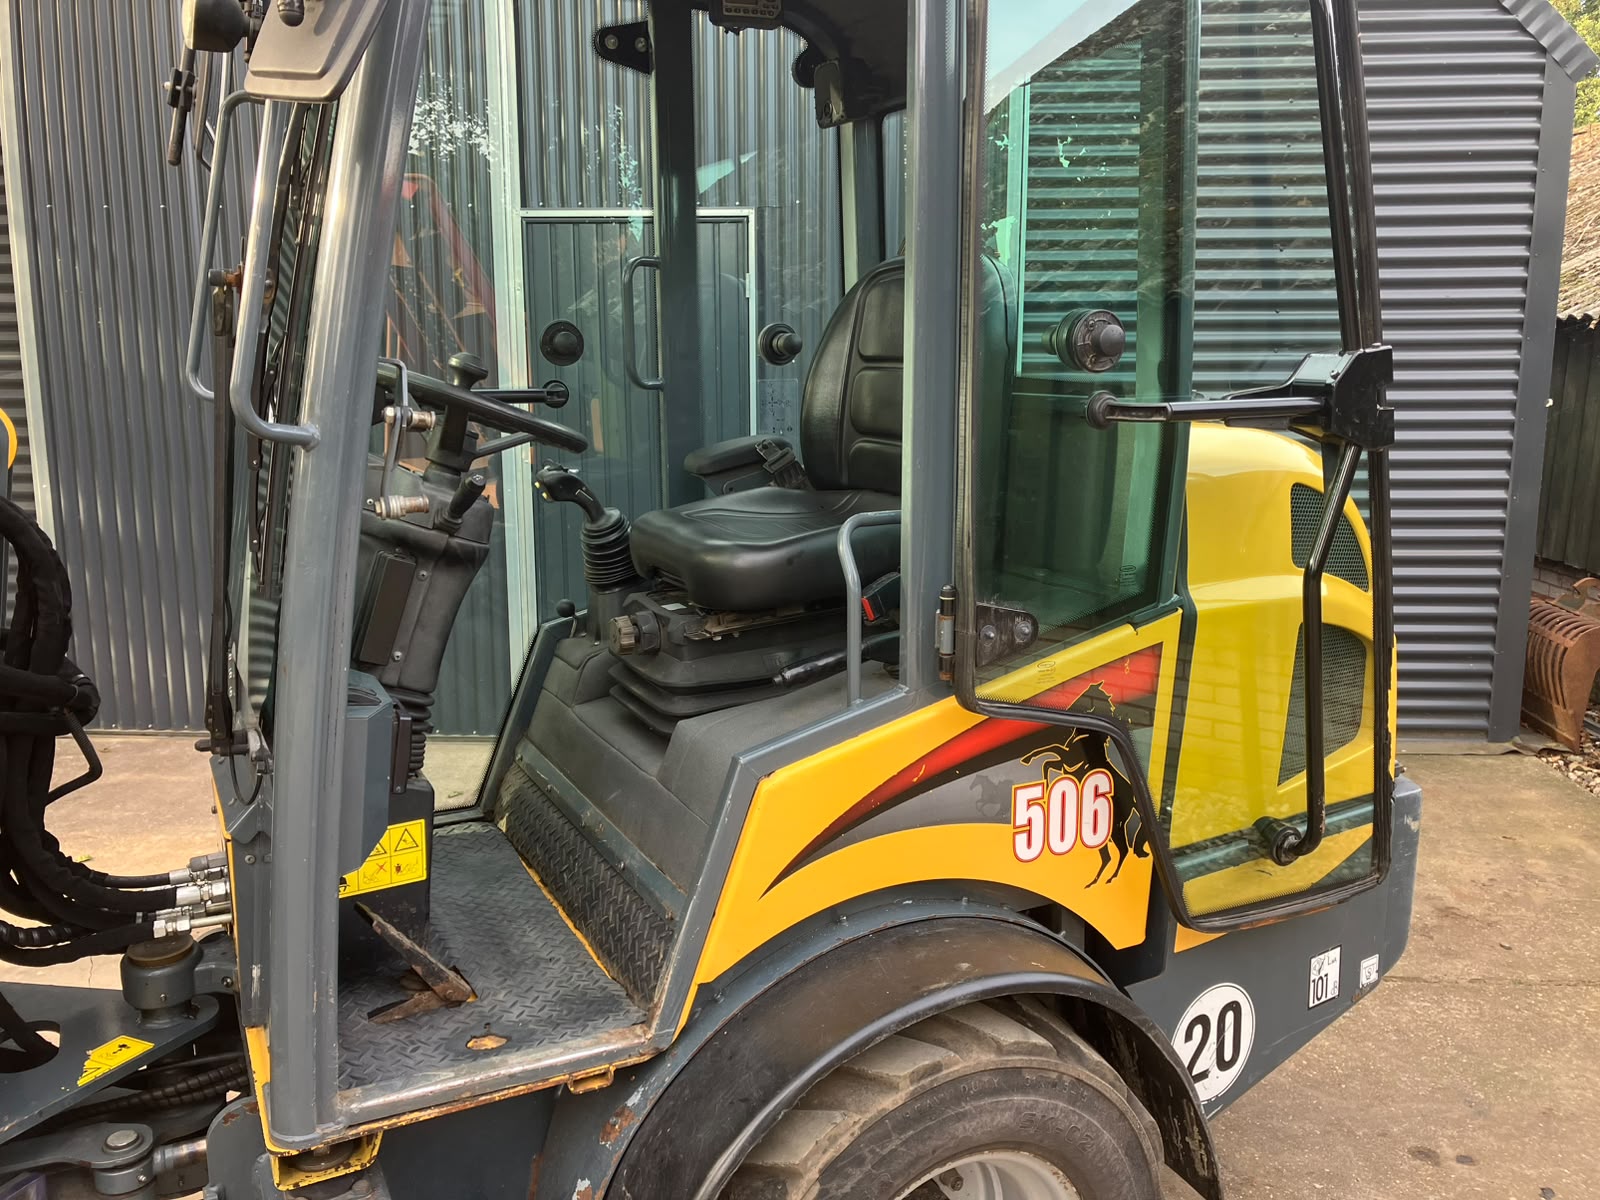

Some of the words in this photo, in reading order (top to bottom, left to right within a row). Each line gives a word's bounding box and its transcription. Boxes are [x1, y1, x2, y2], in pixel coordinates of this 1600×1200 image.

[1012, 768, 1114, 863] 506
[1312, 973, 1329, 1004] 101
[1184, 1000, 1242, 1084] 20
